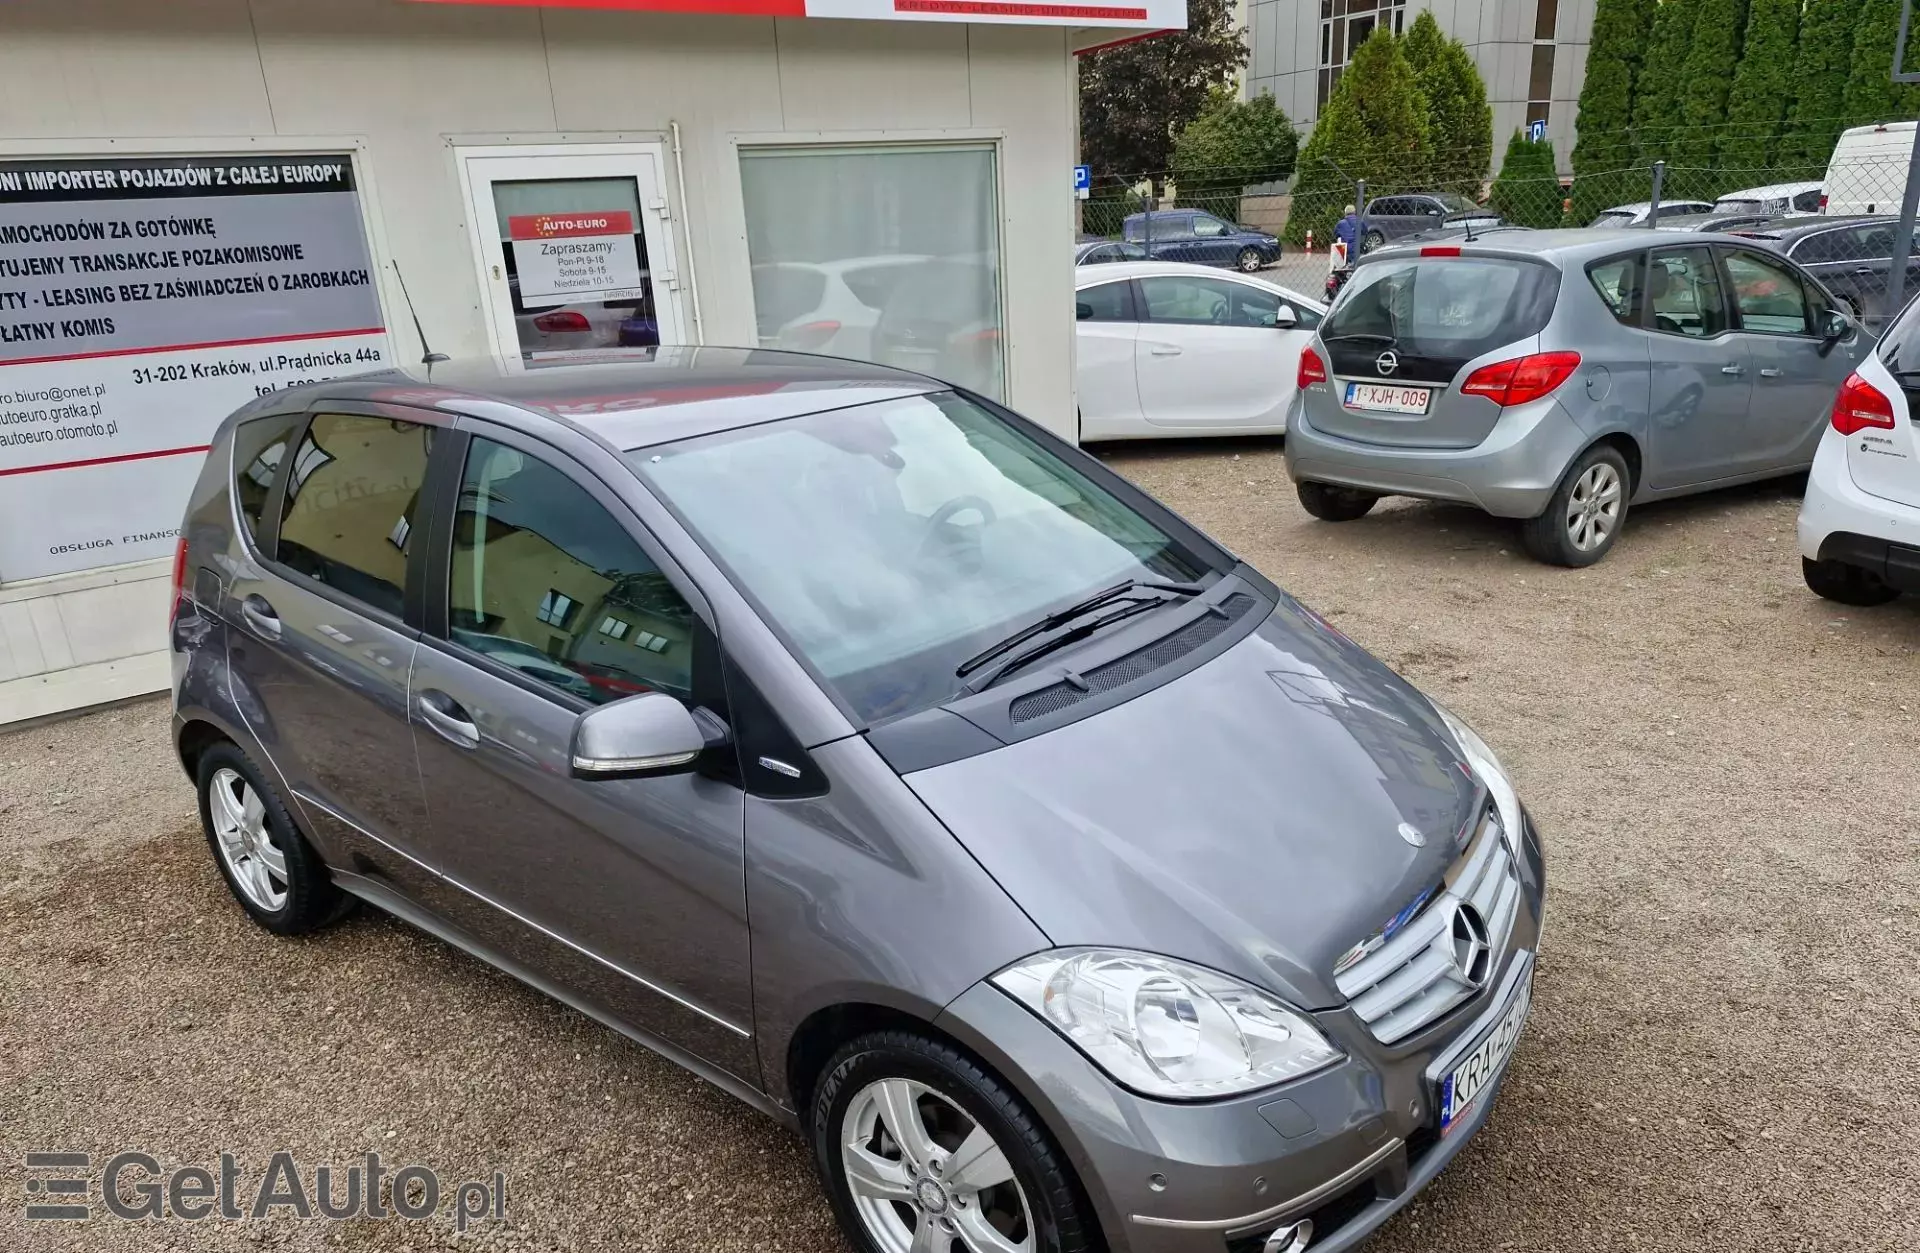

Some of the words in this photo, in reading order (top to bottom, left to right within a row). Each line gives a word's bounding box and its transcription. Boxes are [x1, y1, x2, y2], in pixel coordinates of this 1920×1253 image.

[0, 171, 22, 191] NI
[25, 169, 118, 190] IMPORTER
[119, 164, 211, 189] POJAZDÓW
[214, 167, 227, 185] Z
[230, 165, 279, 184] CAŁEJ
[282, 164, 342, 183] EUROPY
[1075, 169, 1085, 186] P
[108, 221, 132, 239] ZA
[135, 216, 216, 238] GOTÓWKĘ
[543, 219, 607, 231] AUTO-EURO
[69, 250, 179, 273] TRANSAKCJE
[183, 244, 304, 266] POZAKOMISOWE
[541, 241, 616, 258] Zapraszamy:
[586, 256, 604, 264] 9-18
[560, 268, 587, 277] Sobota
[588, 266, 606, 274] 9-15
[593, 276, 614, 285] 10-15
[42, 285, 116, 307] LEASING
[119, 283, 152, 302] BEZ
[154, 272, 264, 300] ZAŚWIADCZEŃ
[268, 275, 279, 291] O
[282, 269, 370, 290] ZAROBKACH
[61, 317, 115, 338] KOMIS
[132, 365, 188, 385] 31-202
[191, 359, 256, 379] Kraków,
[260, 350, 352, 373] ul.Prądnicka
[355, 347, 381, 364] 44a
[0, 401, 102, 426] utoeuro.gratka.pl
[50, 538, 114, 555] OBSŁUGA
[1453, 1041, 1490, 1111] KRA
